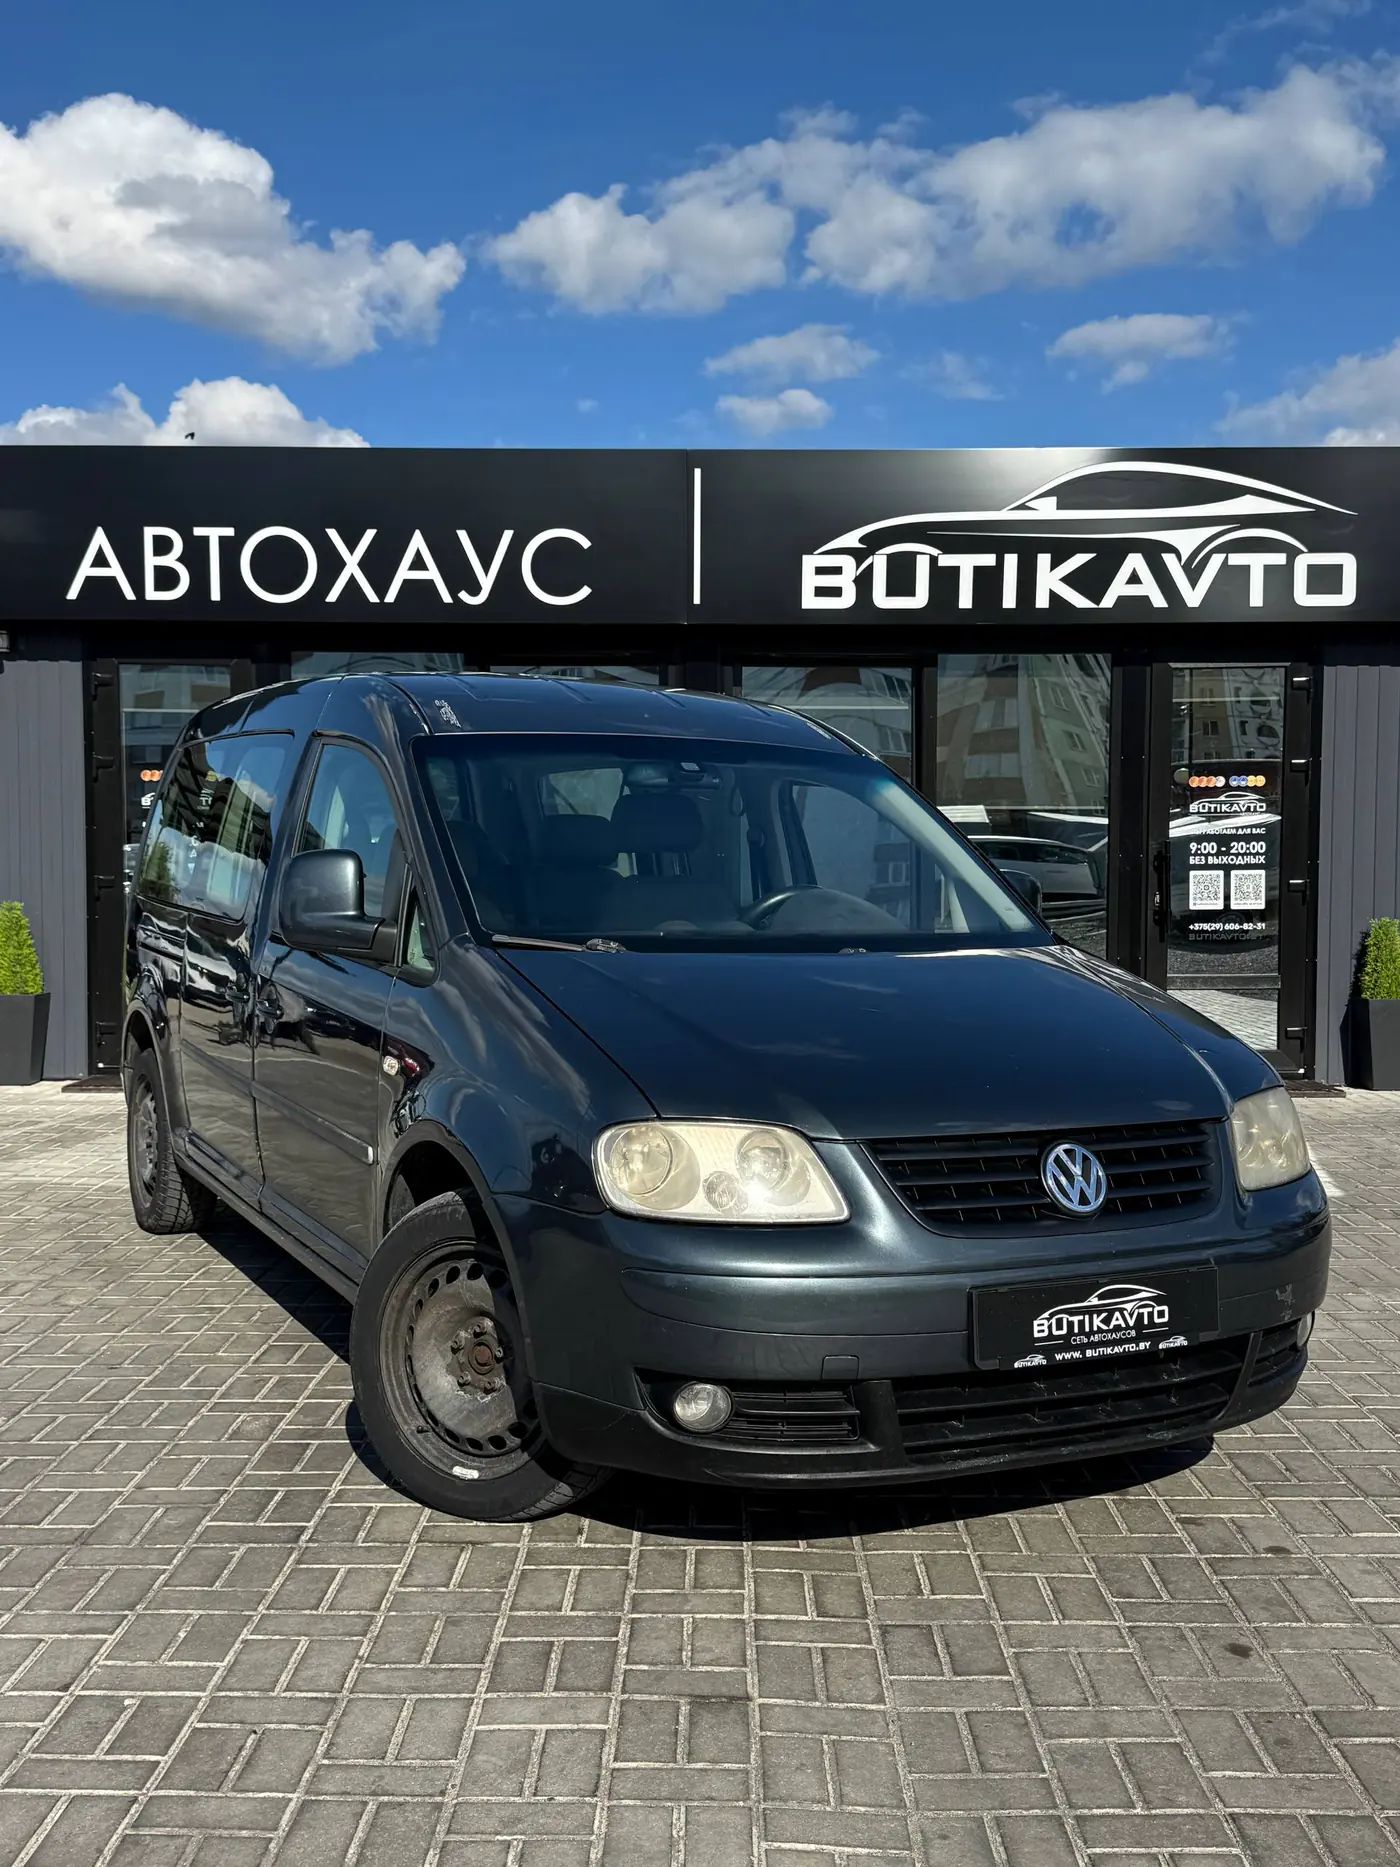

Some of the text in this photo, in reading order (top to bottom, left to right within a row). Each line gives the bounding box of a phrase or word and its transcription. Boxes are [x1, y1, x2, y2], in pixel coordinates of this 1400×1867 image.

[66, 525, 593, 606] АВТОХАУС
[801, 551, 1358, 610] BUTIKAVTO
[1189, 802, 1267, 813] BUTIKAVTO
[1189, 842, 1217, 854] 9:00
[1230, 841, 1266, 853] 20:00
[1189, 855, 1266, 865] БЕЗ ВЫХОДНЫХ
[1188, 922, 1266, 931] +375(29) 606-82-31
[1033, 1305, 1169, 1338] BUTIKAVTO
[1071, 1329, 1136, 1345] СЕТЬ АВТОХАУСОВ
[1055, 1341, 1152, 1361] WWW. BUTIKAVTO.BY
